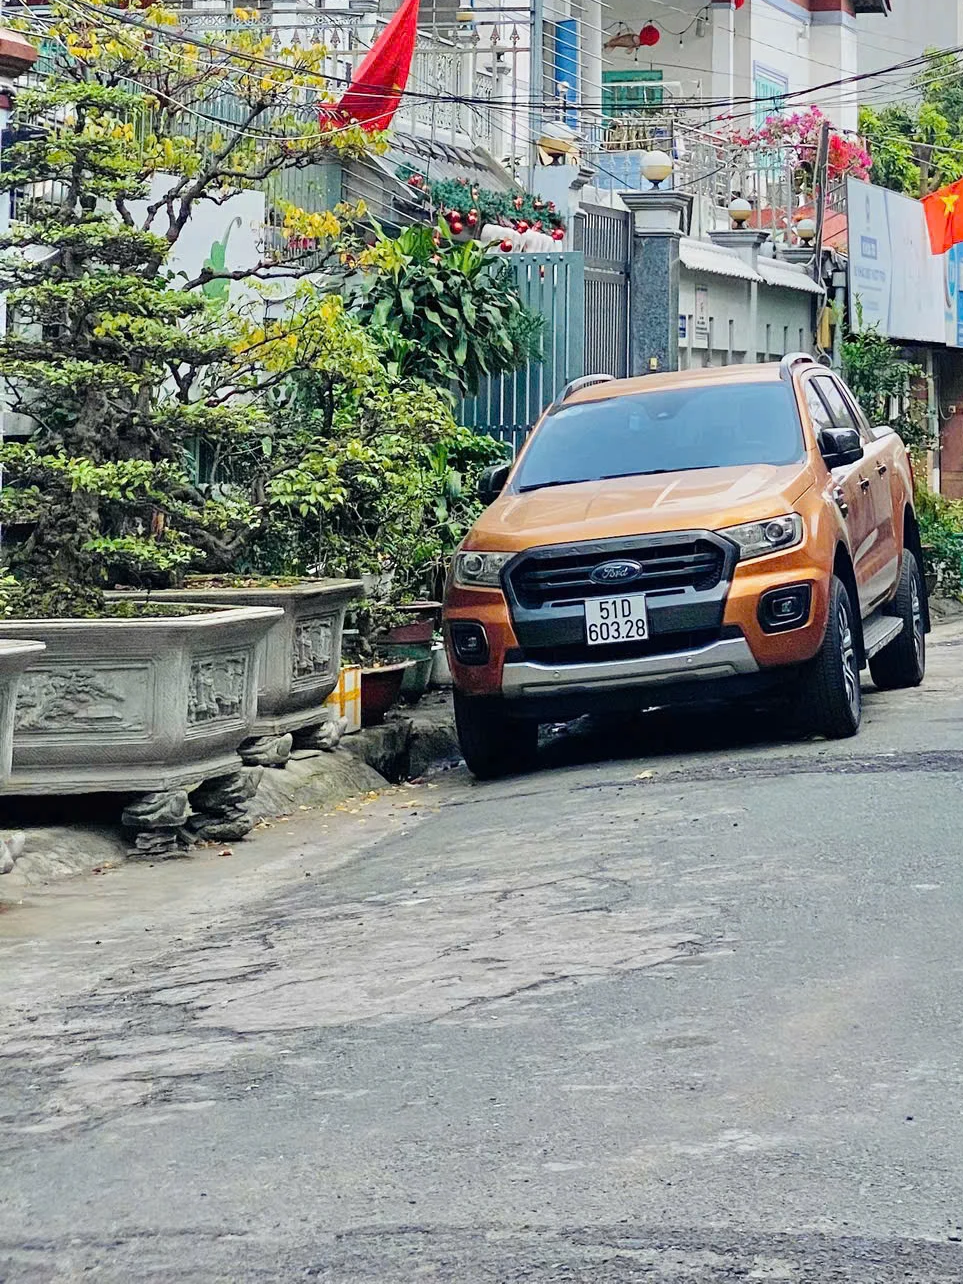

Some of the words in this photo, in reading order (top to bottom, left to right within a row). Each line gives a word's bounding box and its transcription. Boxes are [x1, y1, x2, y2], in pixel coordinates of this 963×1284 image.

[540, 534, 690, 559] RANGER
[601, 565, 629, 579] Ford
[599, 598, 632, 620] 51D
[588, 618, 646, 642] 603.28
